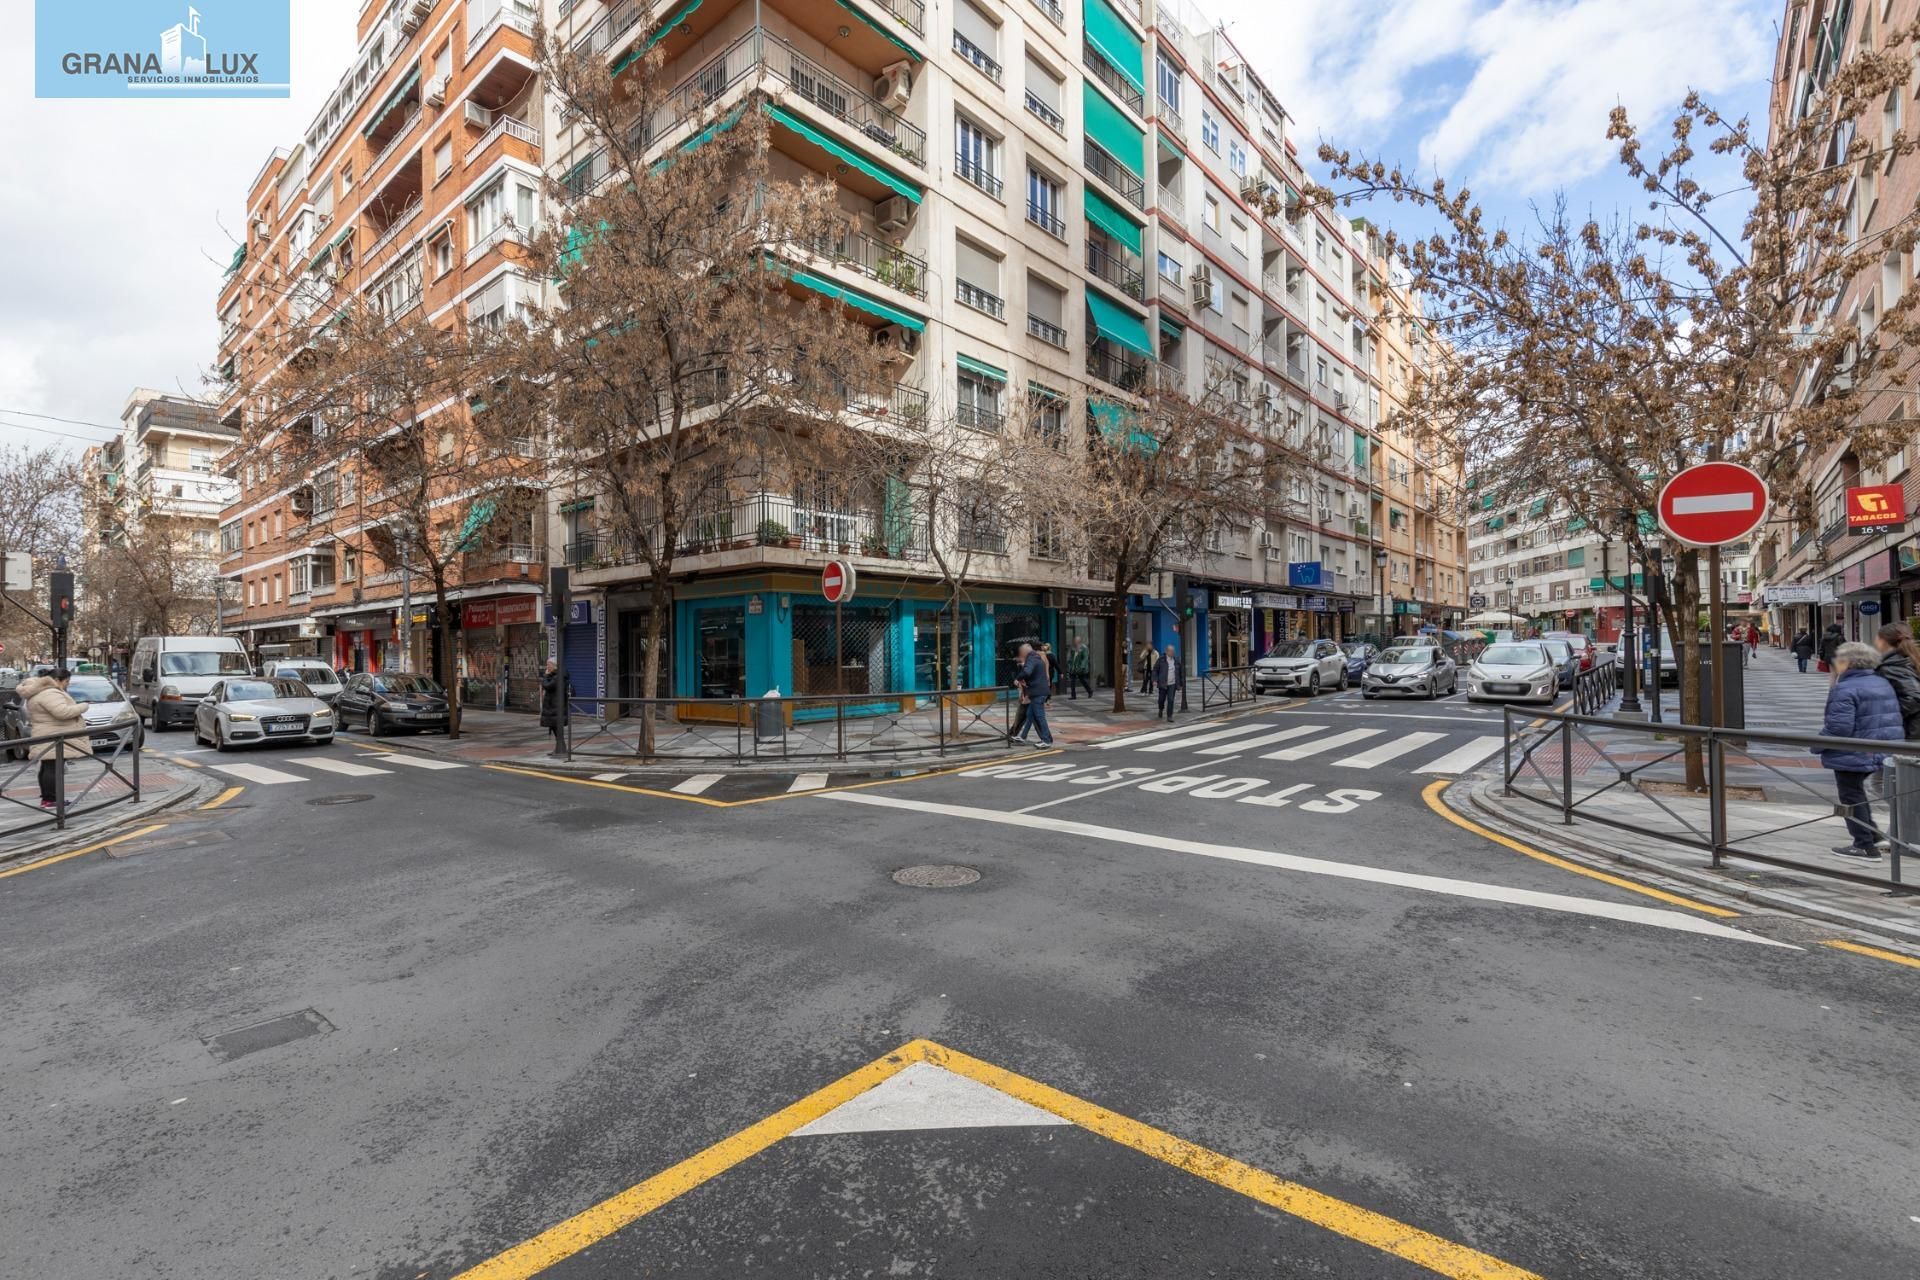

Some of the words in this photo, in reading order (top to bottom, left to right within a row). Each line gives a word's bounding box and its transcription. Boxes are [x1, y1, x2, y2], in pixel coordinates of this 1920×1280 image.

[1849, 512, 1897, 522] TABACOS
[1861, 526, 1874, 534] 16
[958, 763, 1156, 785] STOP
[1138, 774, 1383, 814] STOP
